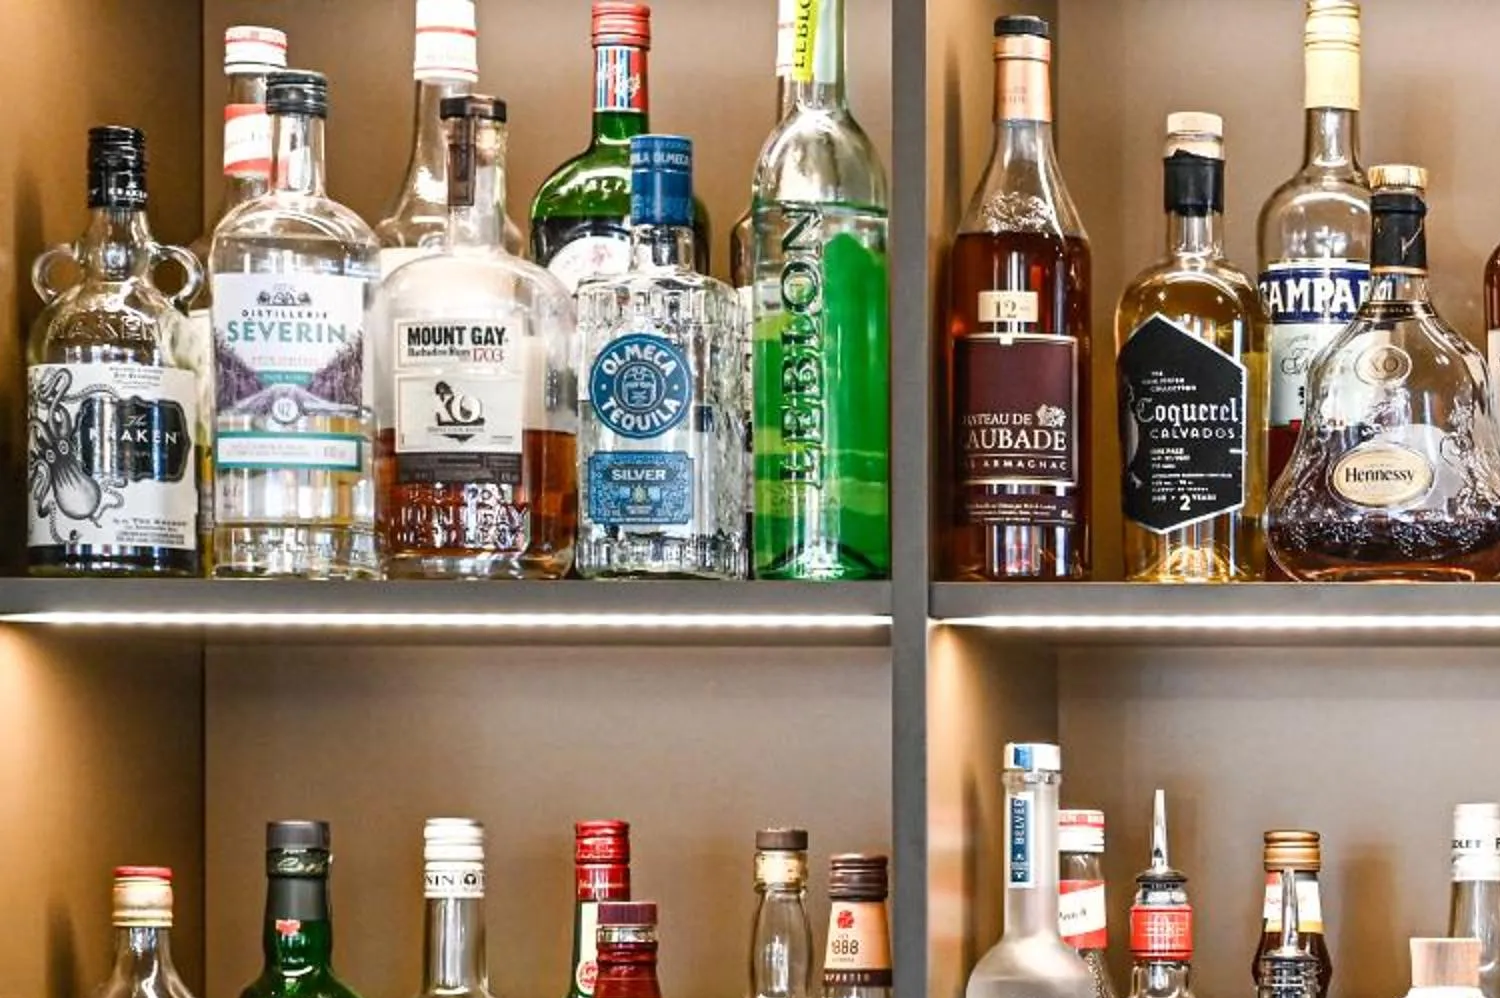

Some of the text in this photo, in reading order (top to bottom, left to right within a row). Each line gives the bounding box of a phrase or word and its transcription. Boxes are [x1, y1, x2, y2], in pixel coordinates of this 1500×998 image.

[1259, 277, 1371, 313] CAMPA
[227, 317, 347, 344] SÉVERIN
[407, 325, 506, 346] MOUNT GAY
[601, 343, 679, 377] OLMECA
[601, 396, 681, 432] TEQUILA
[1012, 413, 1033, 425] DE
[1136, 397, 1239, 427] Coquerel
[966, 428, 1067, 451] AUBADE
[1150, 427, 1235, 439] CALVADOS
[611, 468, 667, 482] SILVER
[1344, 465, 1416, 486] Hennessy
[1179, 493, 1192, 511] 2
